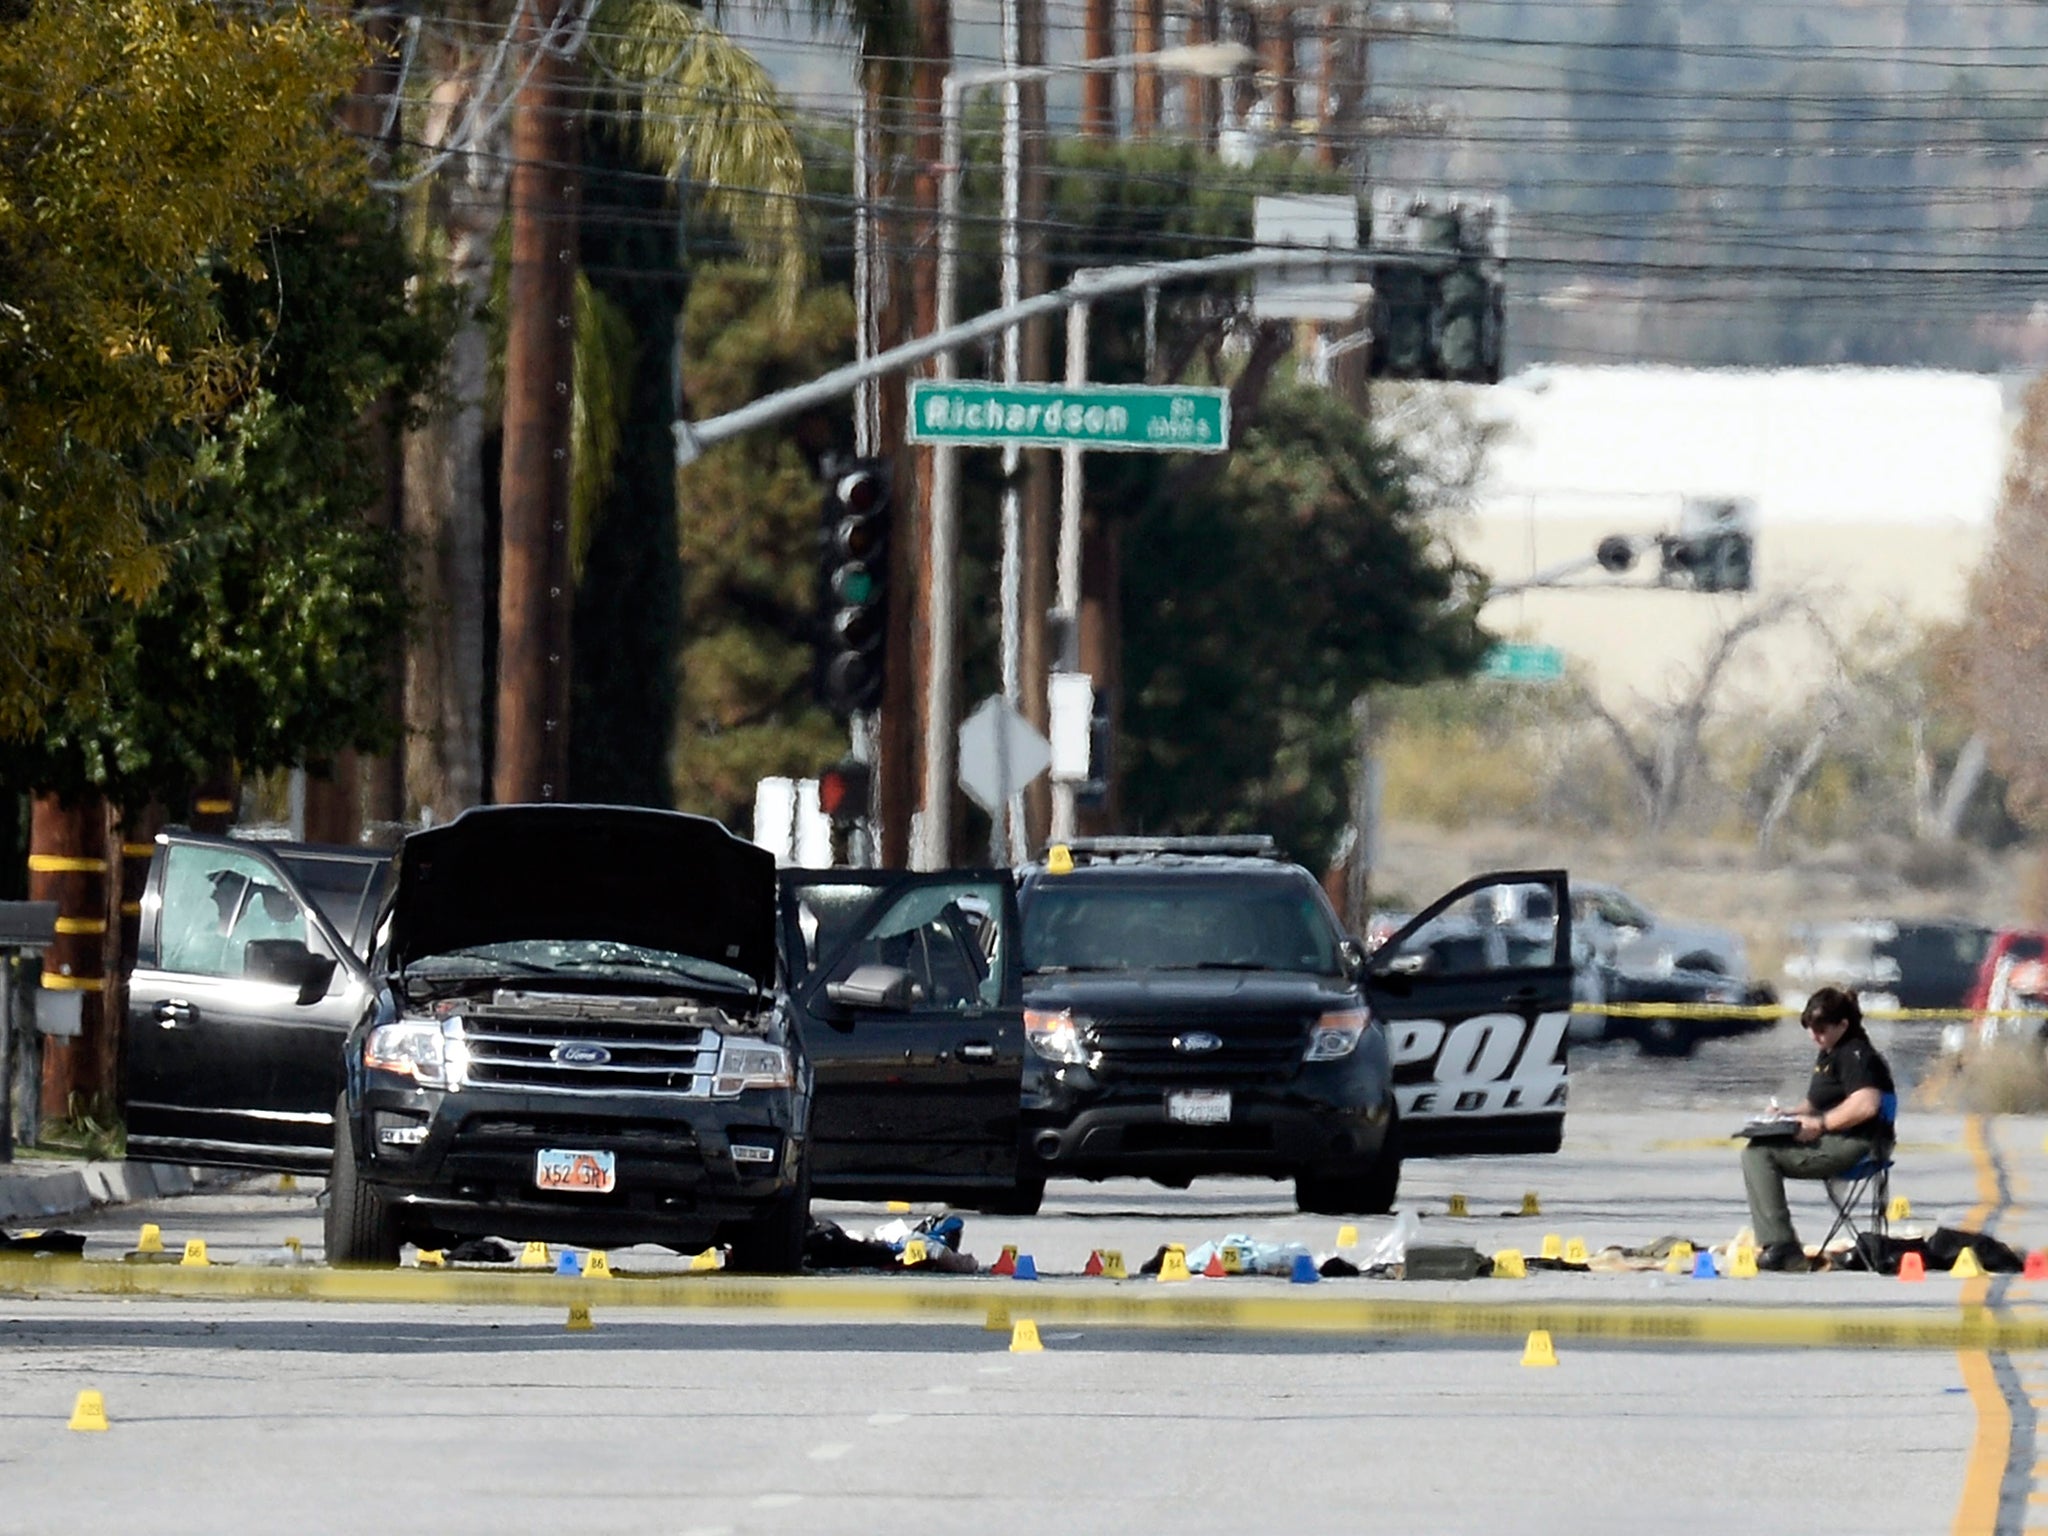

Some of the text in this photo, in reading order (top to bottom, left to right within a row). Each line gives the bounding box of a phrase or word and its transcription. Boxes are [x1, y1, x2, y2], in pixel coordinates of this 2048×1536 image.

[924, 395, 1129, 434] Richardson
[565, 1045, 597, 1061] Ford
[543, 1165, 571, 1185] X52
[1224, 1251, 1237, 1263] 75
